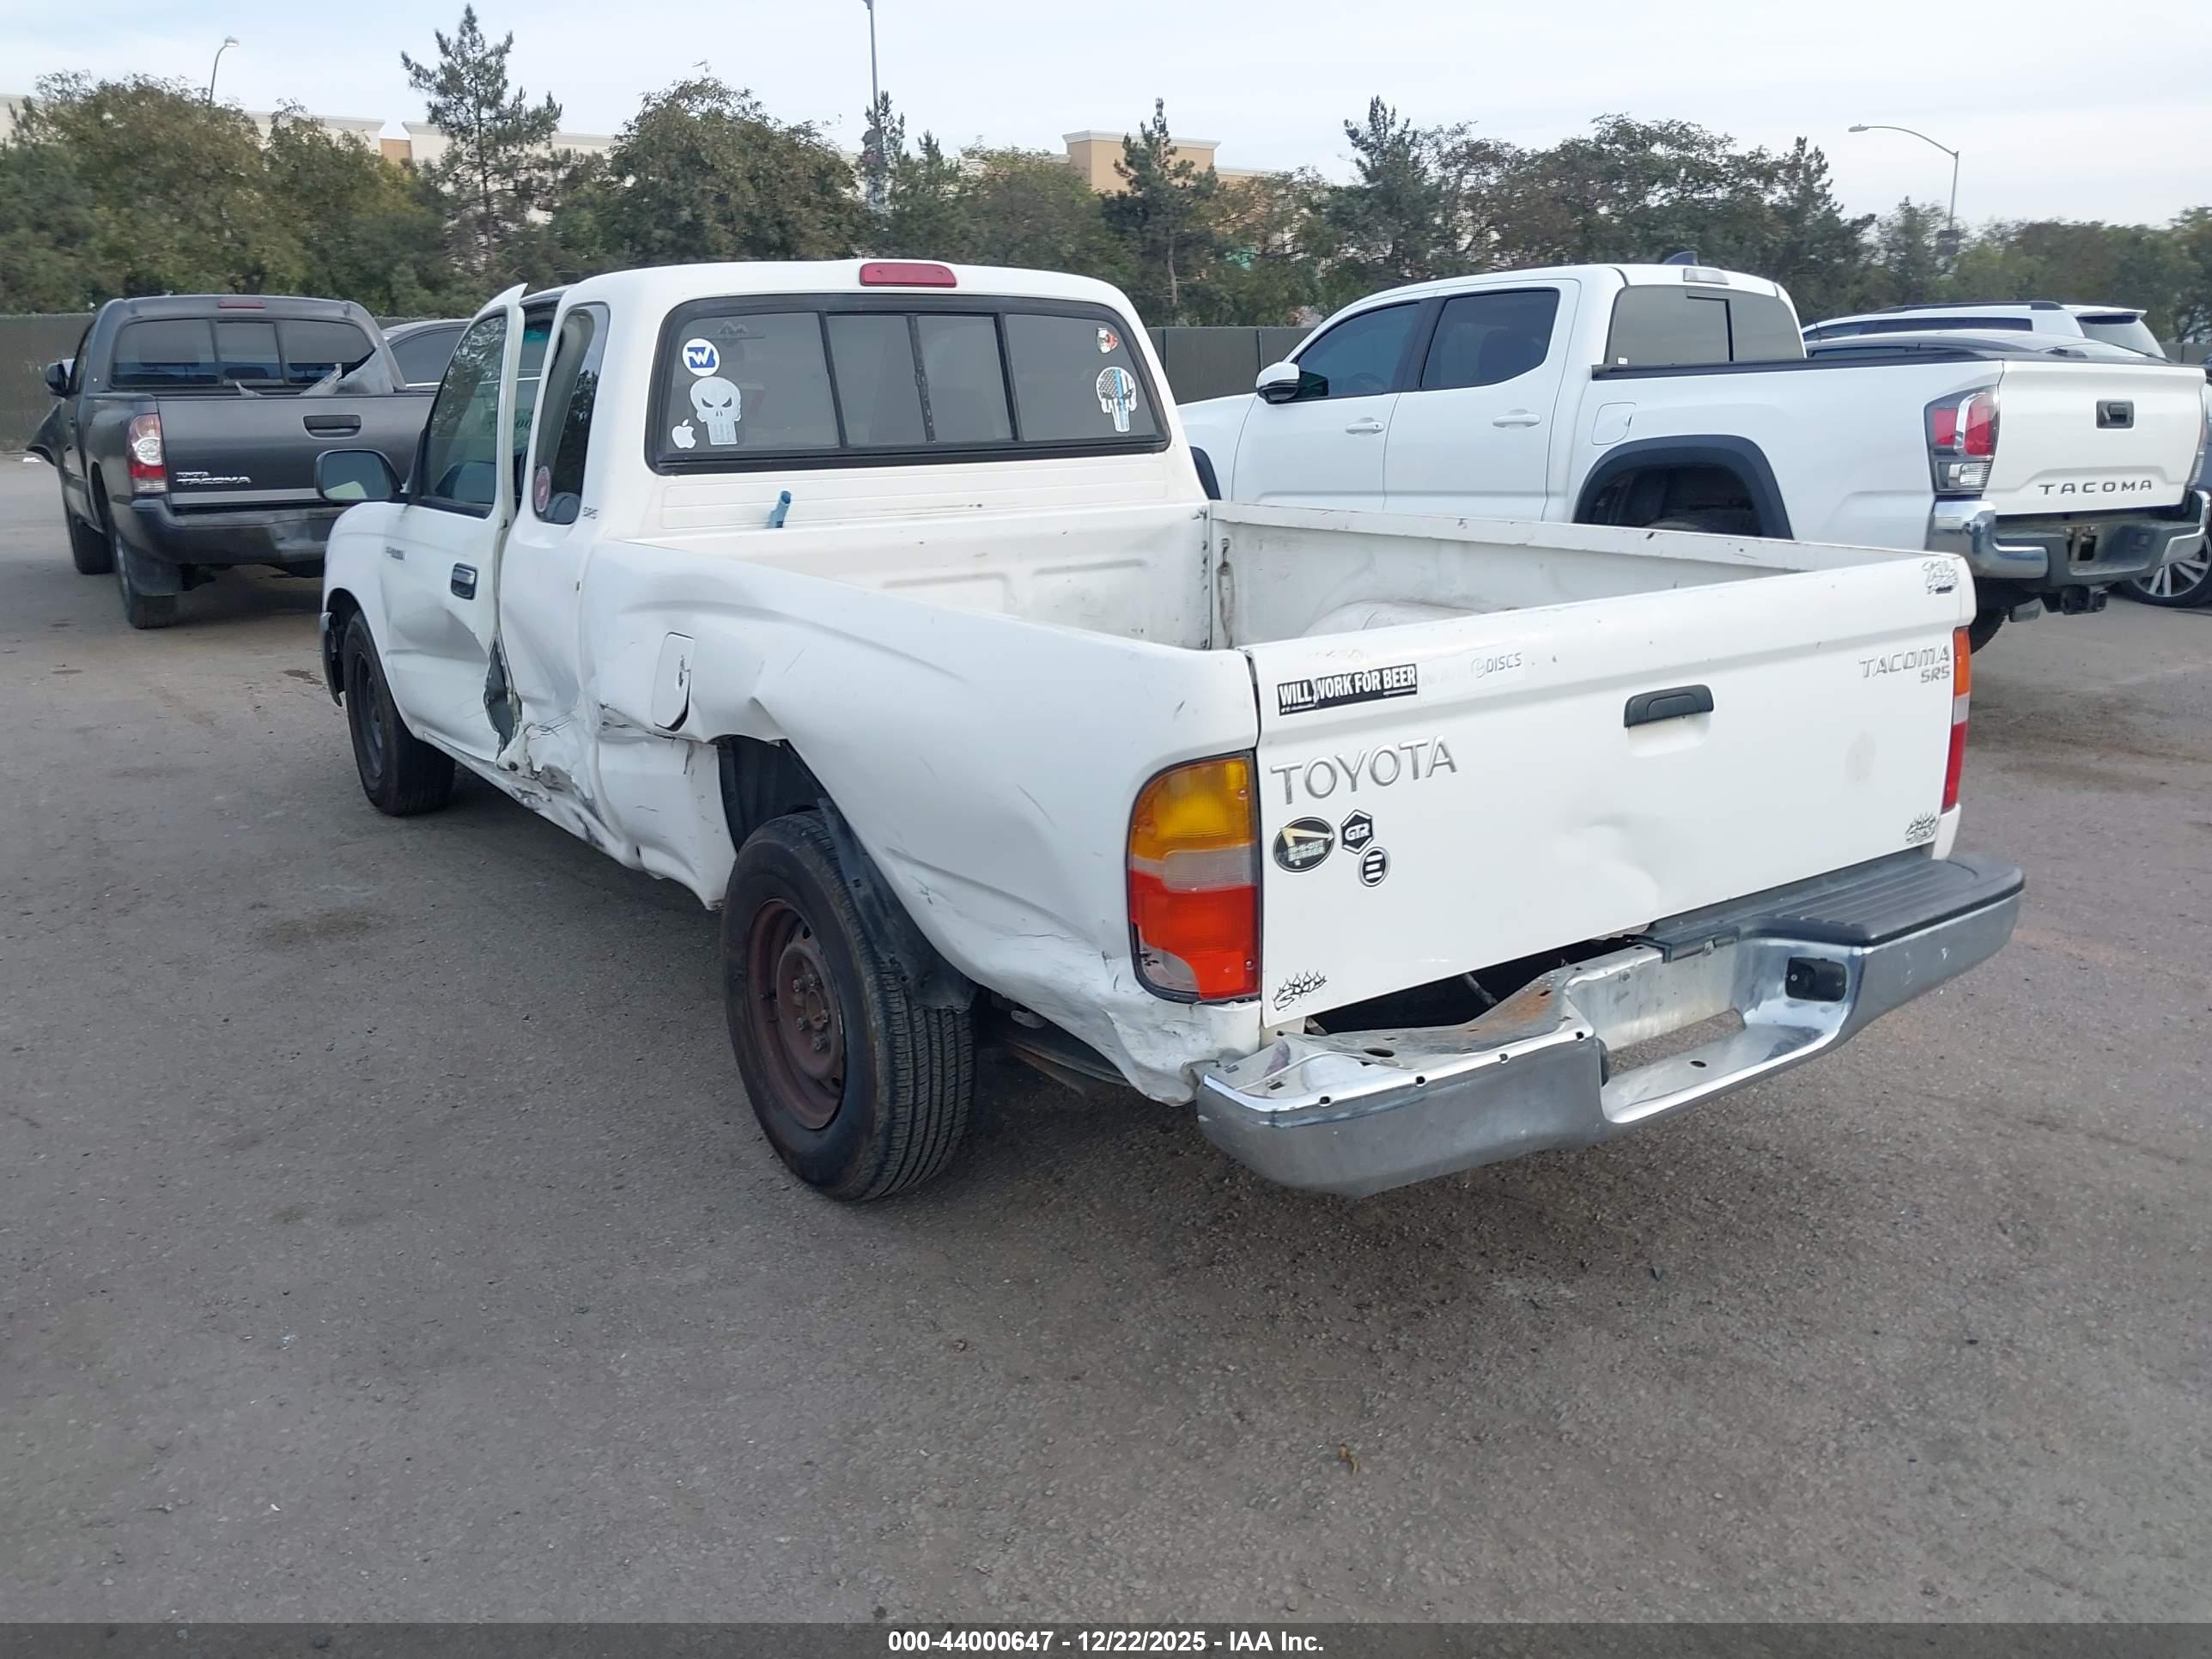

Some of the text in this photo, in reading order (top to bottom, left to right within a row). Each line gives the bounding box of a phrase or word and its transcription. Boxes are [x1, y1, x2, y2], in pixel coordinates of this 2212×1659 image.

[2038, 480, 2152, 495] TACOMA
[1858, 644, 1951, 678] TACOMA
[1279, 665, 1417, 706] WILL WORK FOR BEER
[1270, 734, 1458, 805] TOYOTA
